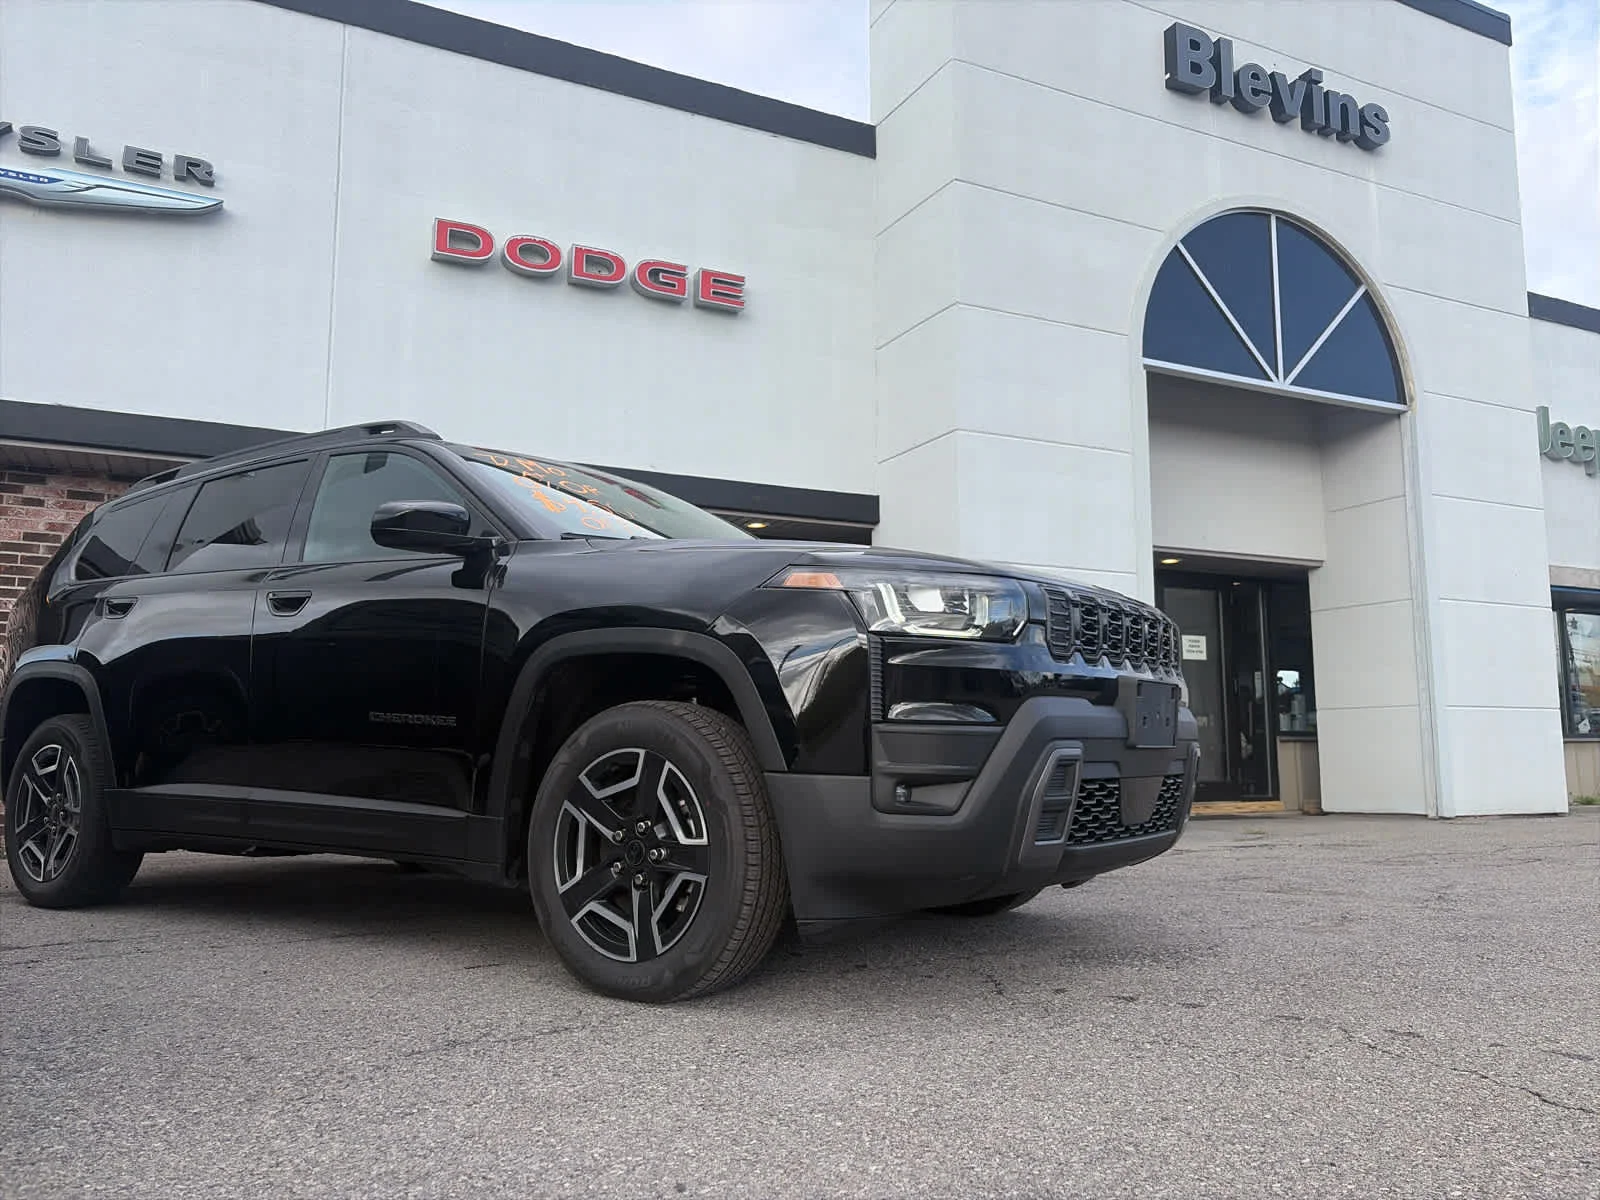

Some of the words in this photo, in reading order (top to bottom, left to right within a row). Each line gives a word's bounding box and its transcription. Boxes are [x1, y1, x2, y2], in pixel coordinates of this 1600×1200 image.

[1163, 22, 1390, 150] Blevins
[0, 121, 215, 187] SLER
[431, 217, 746, 315] DODGE
